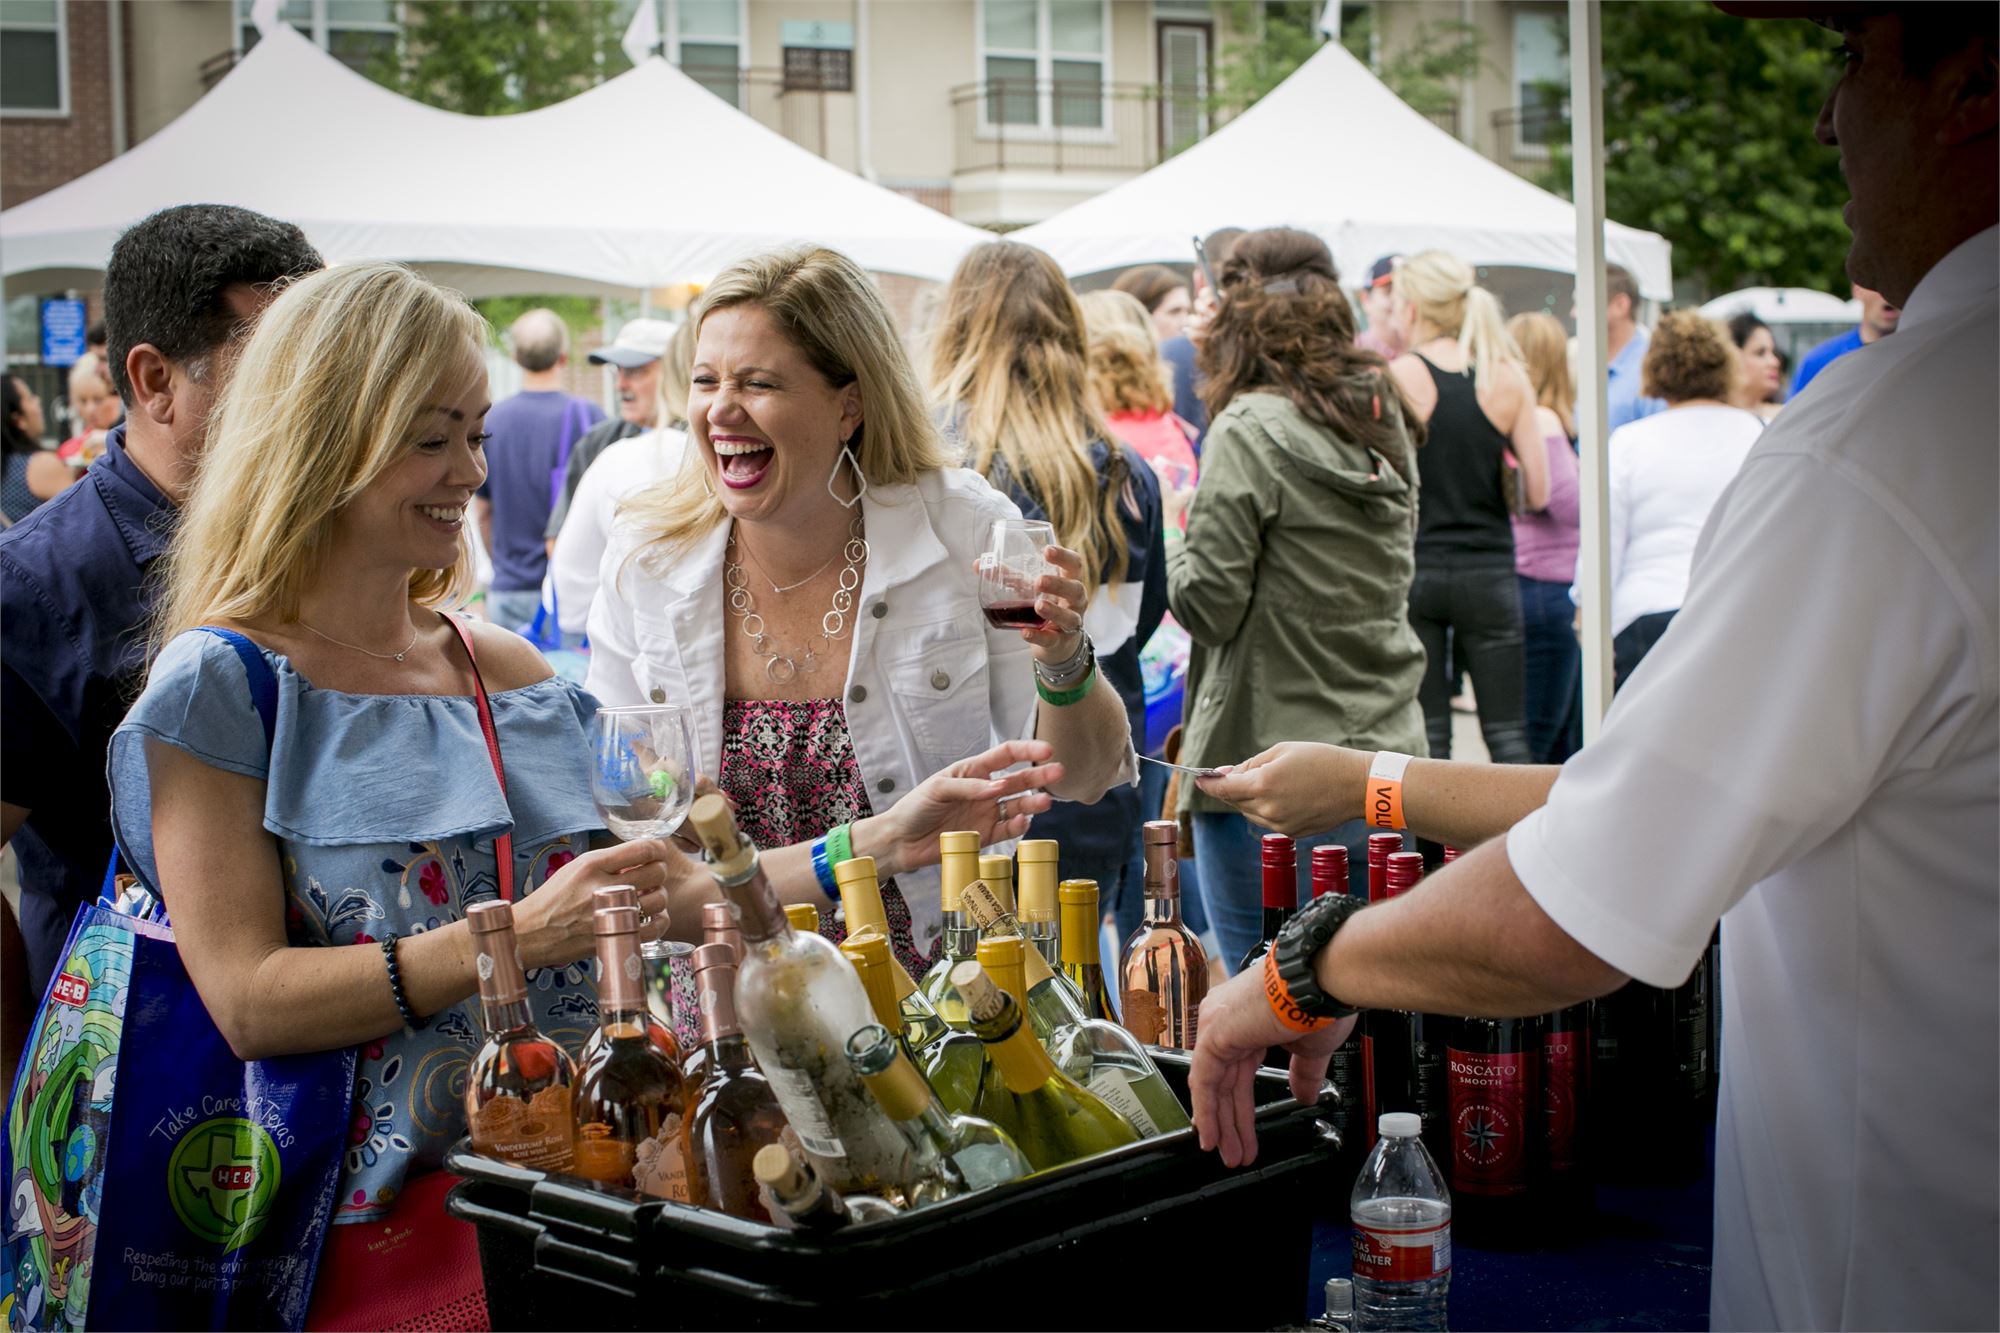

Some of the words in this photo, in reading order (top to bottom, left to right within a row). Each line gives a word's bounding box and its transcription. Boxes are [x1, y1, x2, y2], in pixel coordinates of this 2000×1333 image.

[1451, 1061, 1516, 1076] ROSCATO
[1459, 1076, 1502, 1087] SMOOTH
[149, 1106, 198, 1141] Take
[202, 1095, 241, 1116] Care
[244, 1096, 263, 1114] of
[261, 1100, 295, 1149] Texas
[122, 1247, 189, 1274] Respecting
[194, 1255, 217, 1273] the
[1359, 1252, 1392, 1266] WATER
[131, 1265, 166, 1288] Doing
